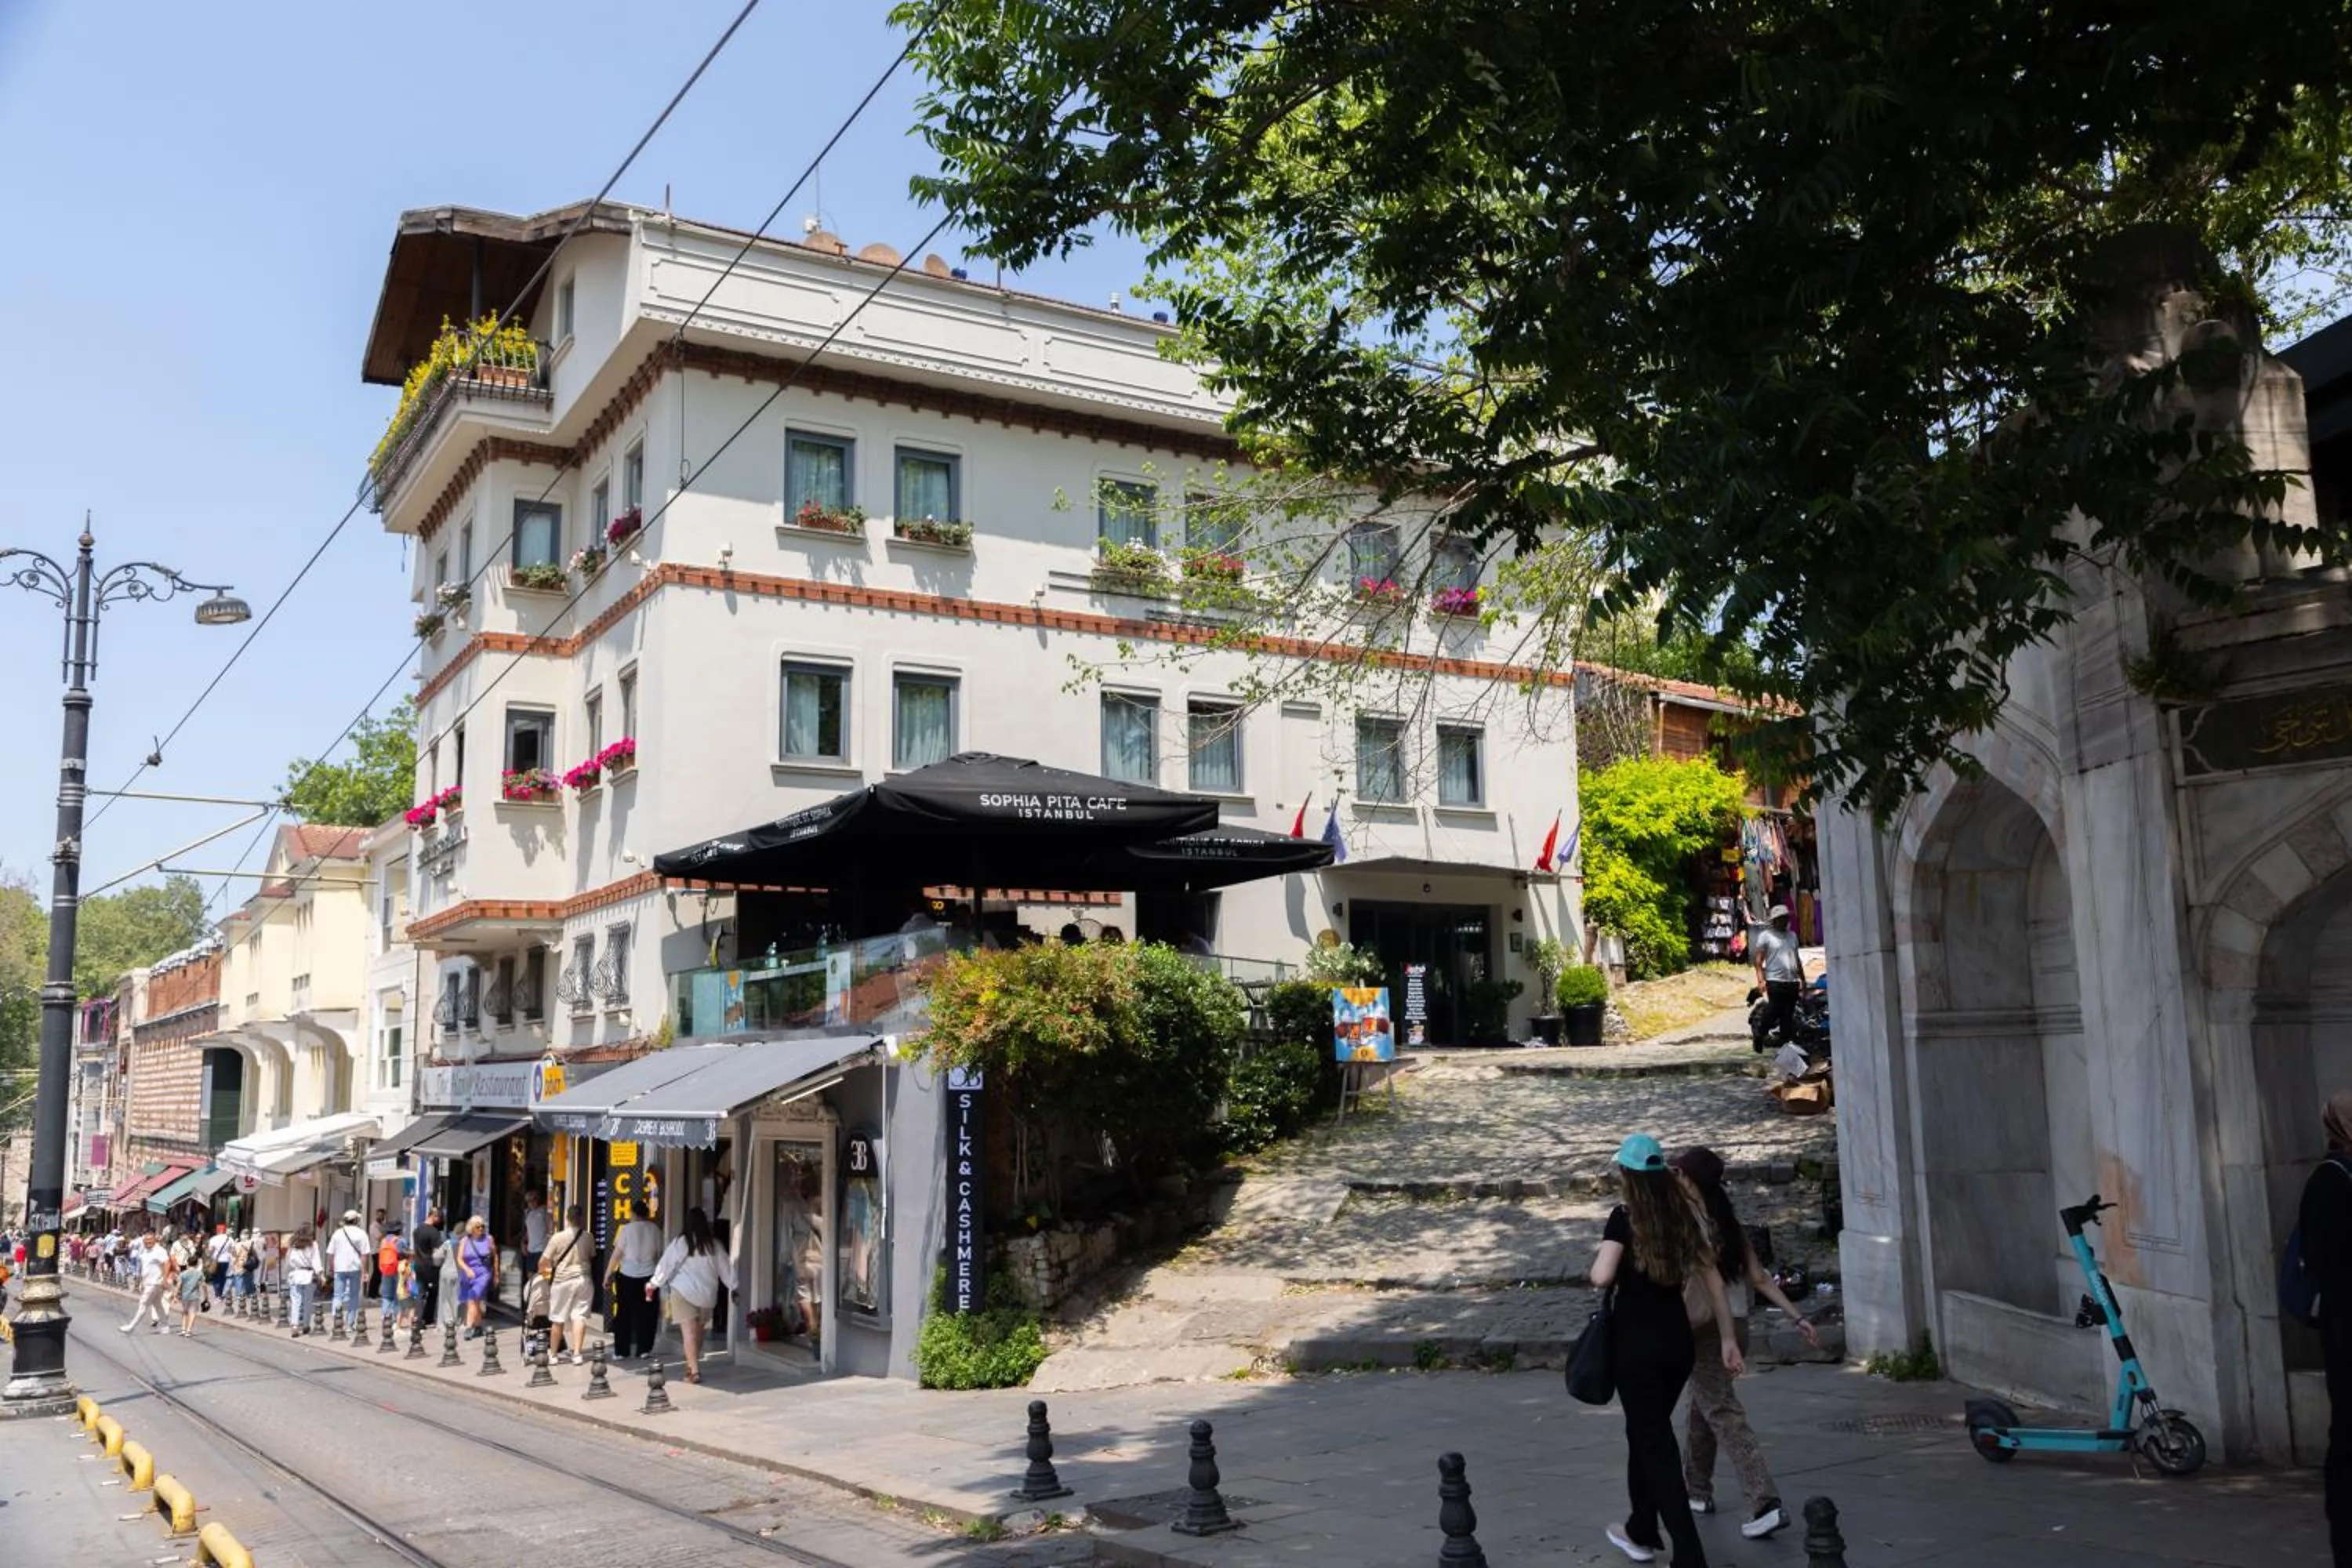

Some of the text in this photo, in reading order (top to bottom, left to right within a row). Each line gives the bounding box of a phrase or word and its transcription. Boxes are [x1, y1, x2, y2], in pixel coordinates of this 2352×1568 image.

[980, 794, 1127, 811] SOPHIA PITA CAFE
[1018, 808, 1094, 820] ISTANBUL
[956, 1094, 972, 1310] SILK & CASHMERE
